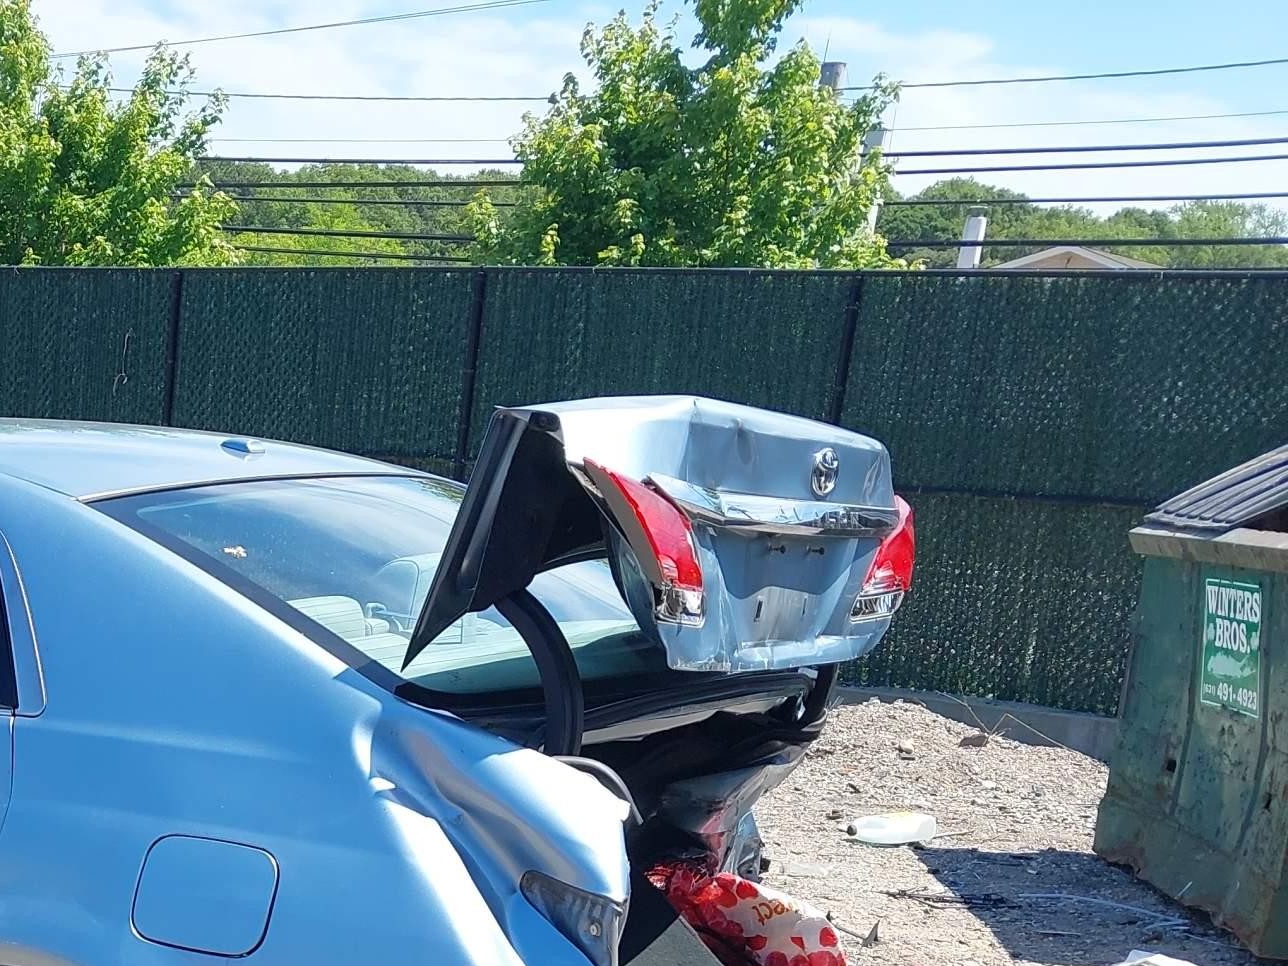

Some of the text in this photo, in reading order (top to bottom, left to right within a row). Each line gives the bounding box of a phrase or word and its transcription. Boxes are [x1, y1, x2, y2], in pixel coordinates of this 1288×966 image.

[1207, 585, 1260, 624] WINTERS
[1215, 618, 1250, 654] BROS.
[1217, 681, 1257, 711] 491-4923
